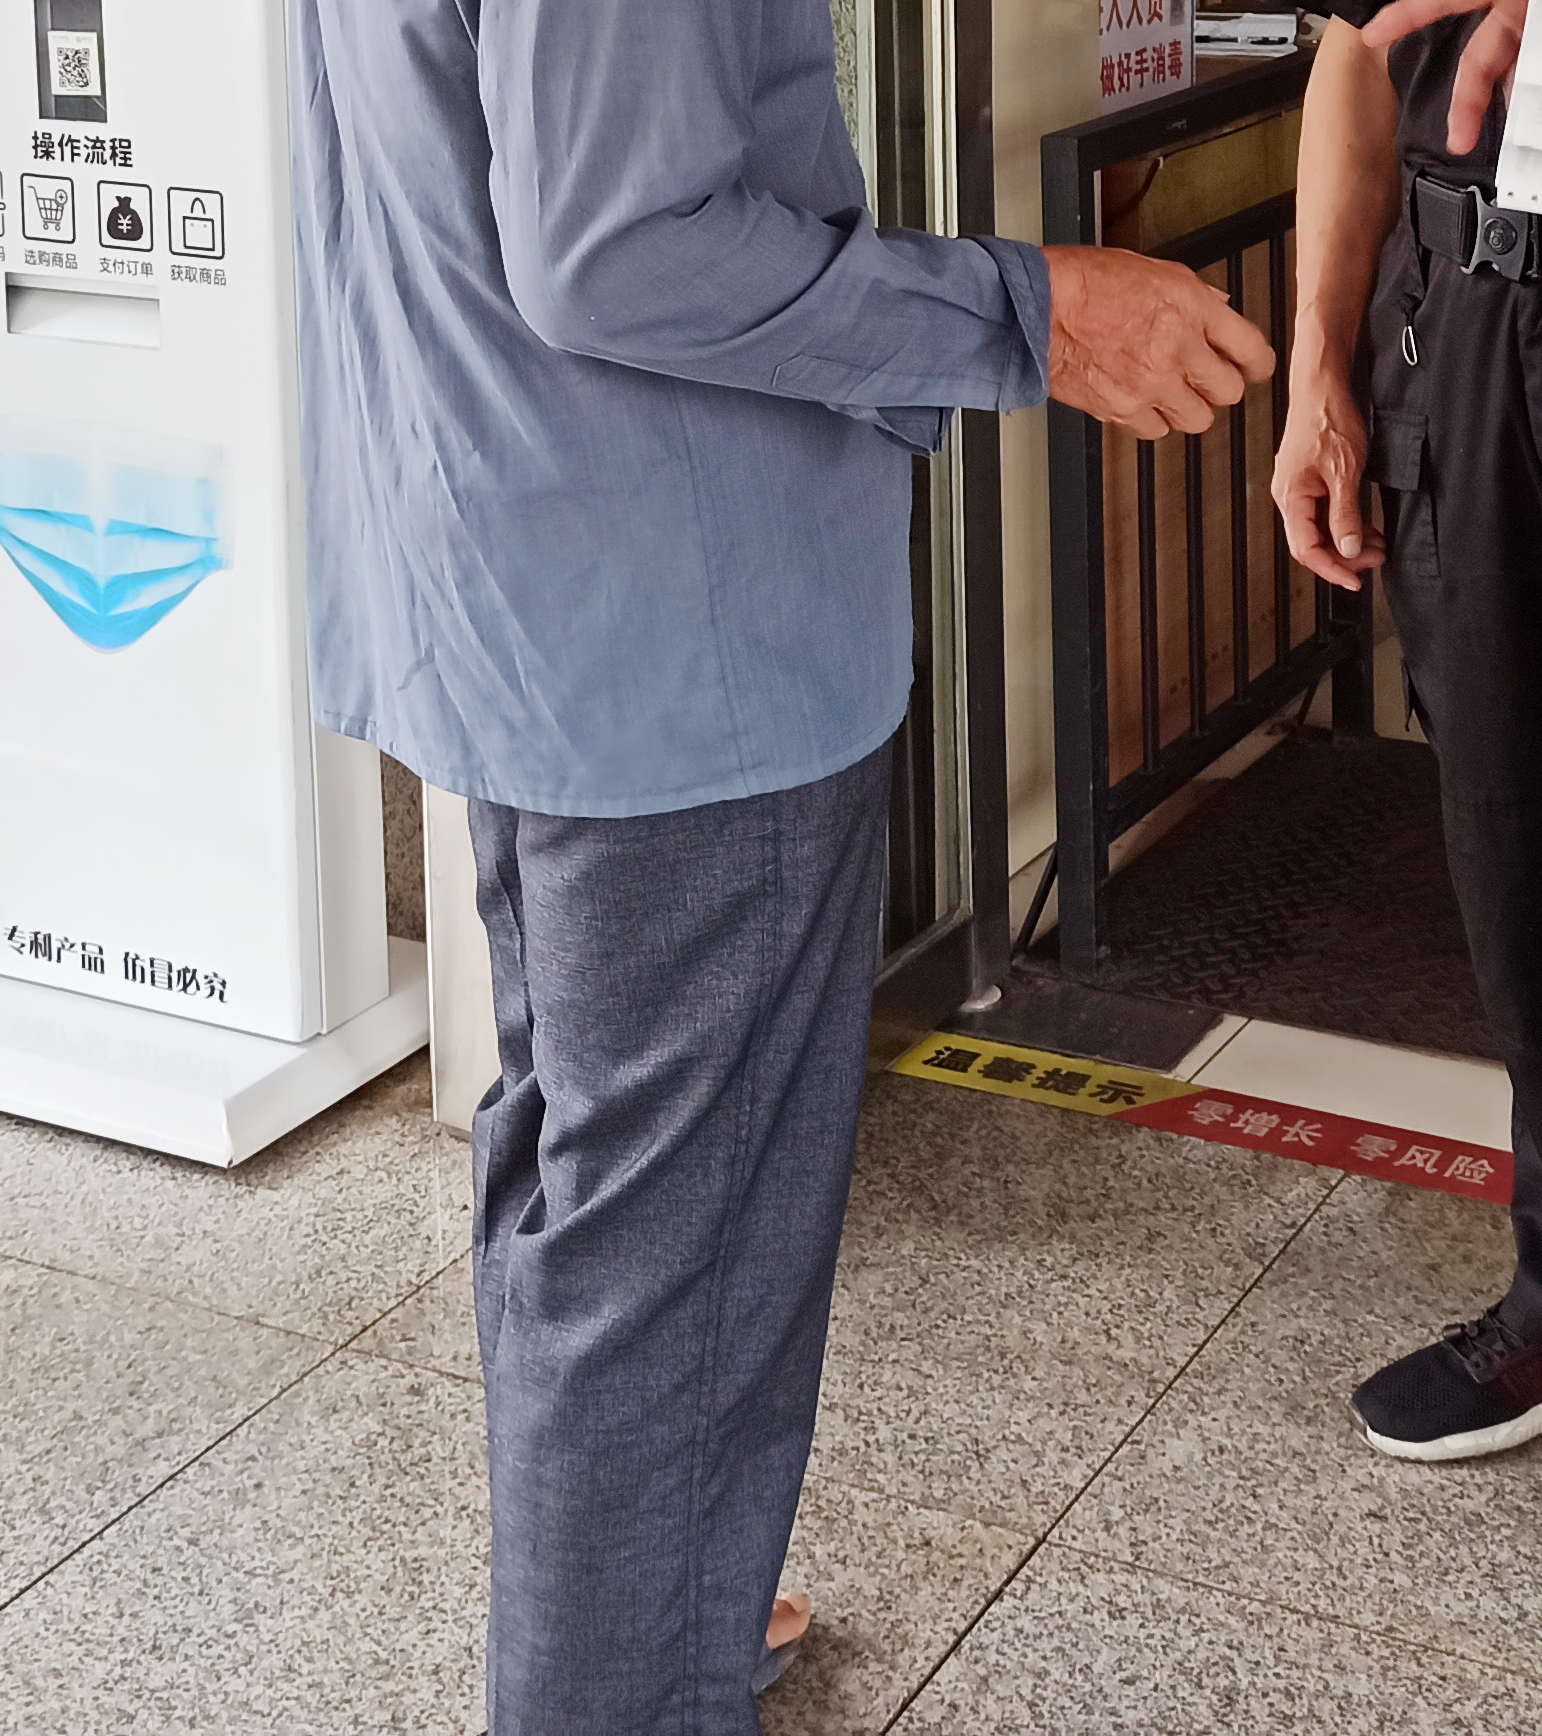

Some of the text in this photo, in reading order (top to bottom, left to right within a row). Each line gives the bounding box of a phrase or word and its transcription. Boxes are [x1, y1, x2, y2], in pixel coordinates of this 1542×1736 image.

[31, 130, 134, 168] 操作流程
[24, 248, 78, 271] 选购商品
[99, 255, 155, 279] 支付订单
[170, 263, 227, 287] 获取商品
[3, 923, 228, 1004] 专利产品 仿冒必究
[921, 1044, 1146, 1108] 温馨提示
[1186, 1098, 1496, 1188] 零增长 零风险
